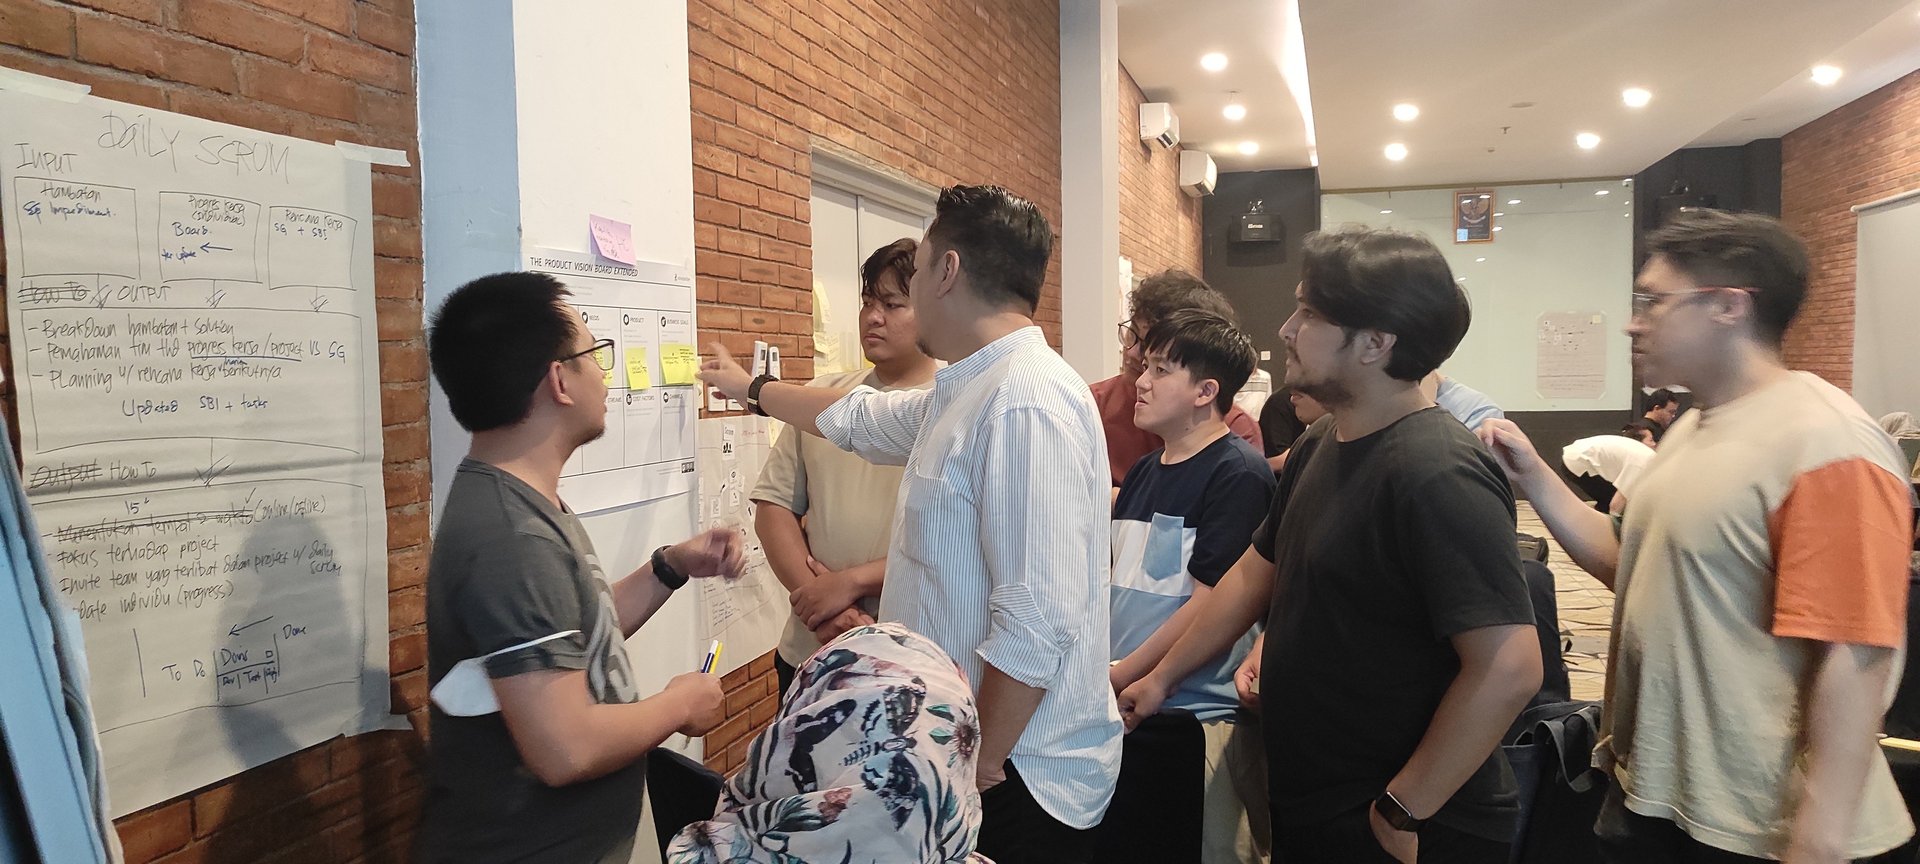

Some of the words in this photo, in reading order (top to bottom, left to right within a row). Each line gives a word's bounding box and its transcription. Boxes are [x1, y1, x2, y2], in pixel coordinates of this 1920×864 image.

[195, 135, 289, 184] SCRUM
[530, 257, 542, 267] THE
[545, 259, 572, 270] PRODUCT
[574, 262, 594, 273] VISION
[594, 264, 612, 275] BOARD
[614, 267, 639, 277] EXTENDED
[117, 285, 171, 303] OUTPUT
[329, 341, 345, 364] SG
[180, 535, 219, 559] project
[110, 571, 138, 586] team
[145, 568, 171, 588] yang
[162, 664, 181, 681] To
[193, 659, 206, 678] Do
